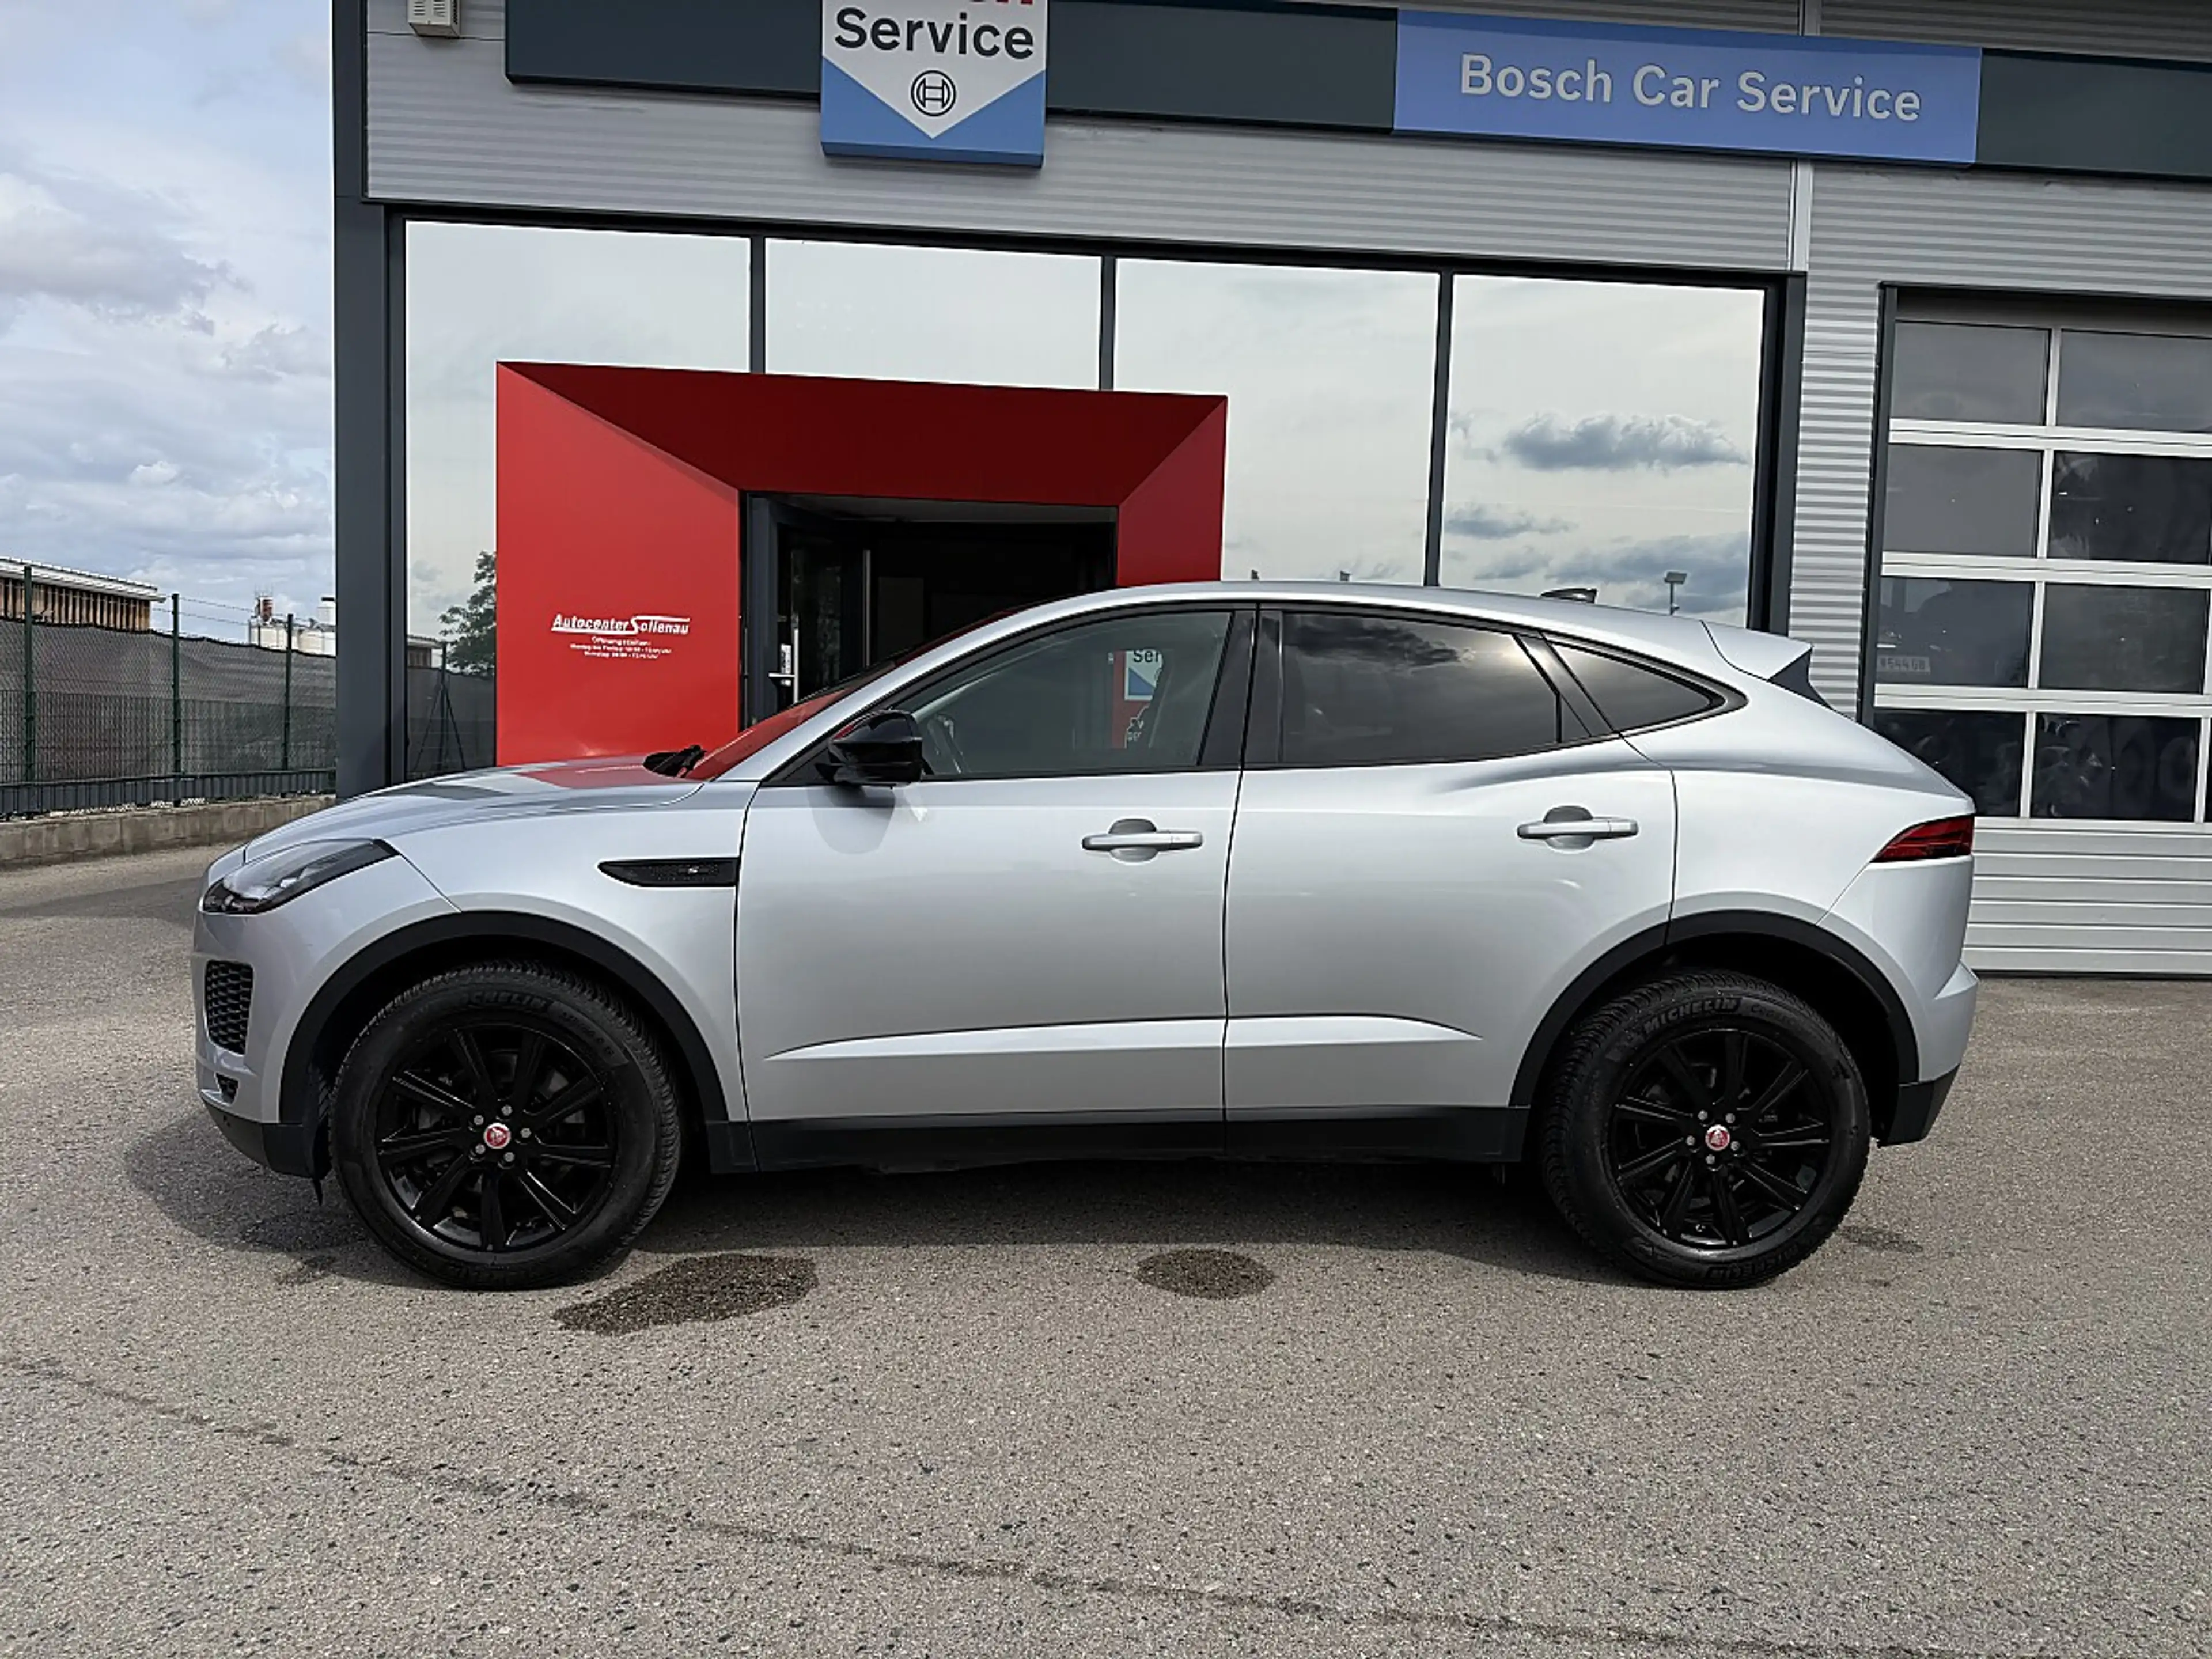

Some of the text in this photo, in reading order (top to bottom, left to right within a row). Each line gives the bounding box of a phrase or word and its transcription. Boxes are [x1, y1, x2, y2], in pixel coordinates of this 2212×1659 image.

[835, 7, 1033, 59] Service
[1460, 52, 1922, 122] Bosch Car Service
[551, 613, 630, 634] Autocenter
[1643, 998, 1738, 1035] MICHELIN
